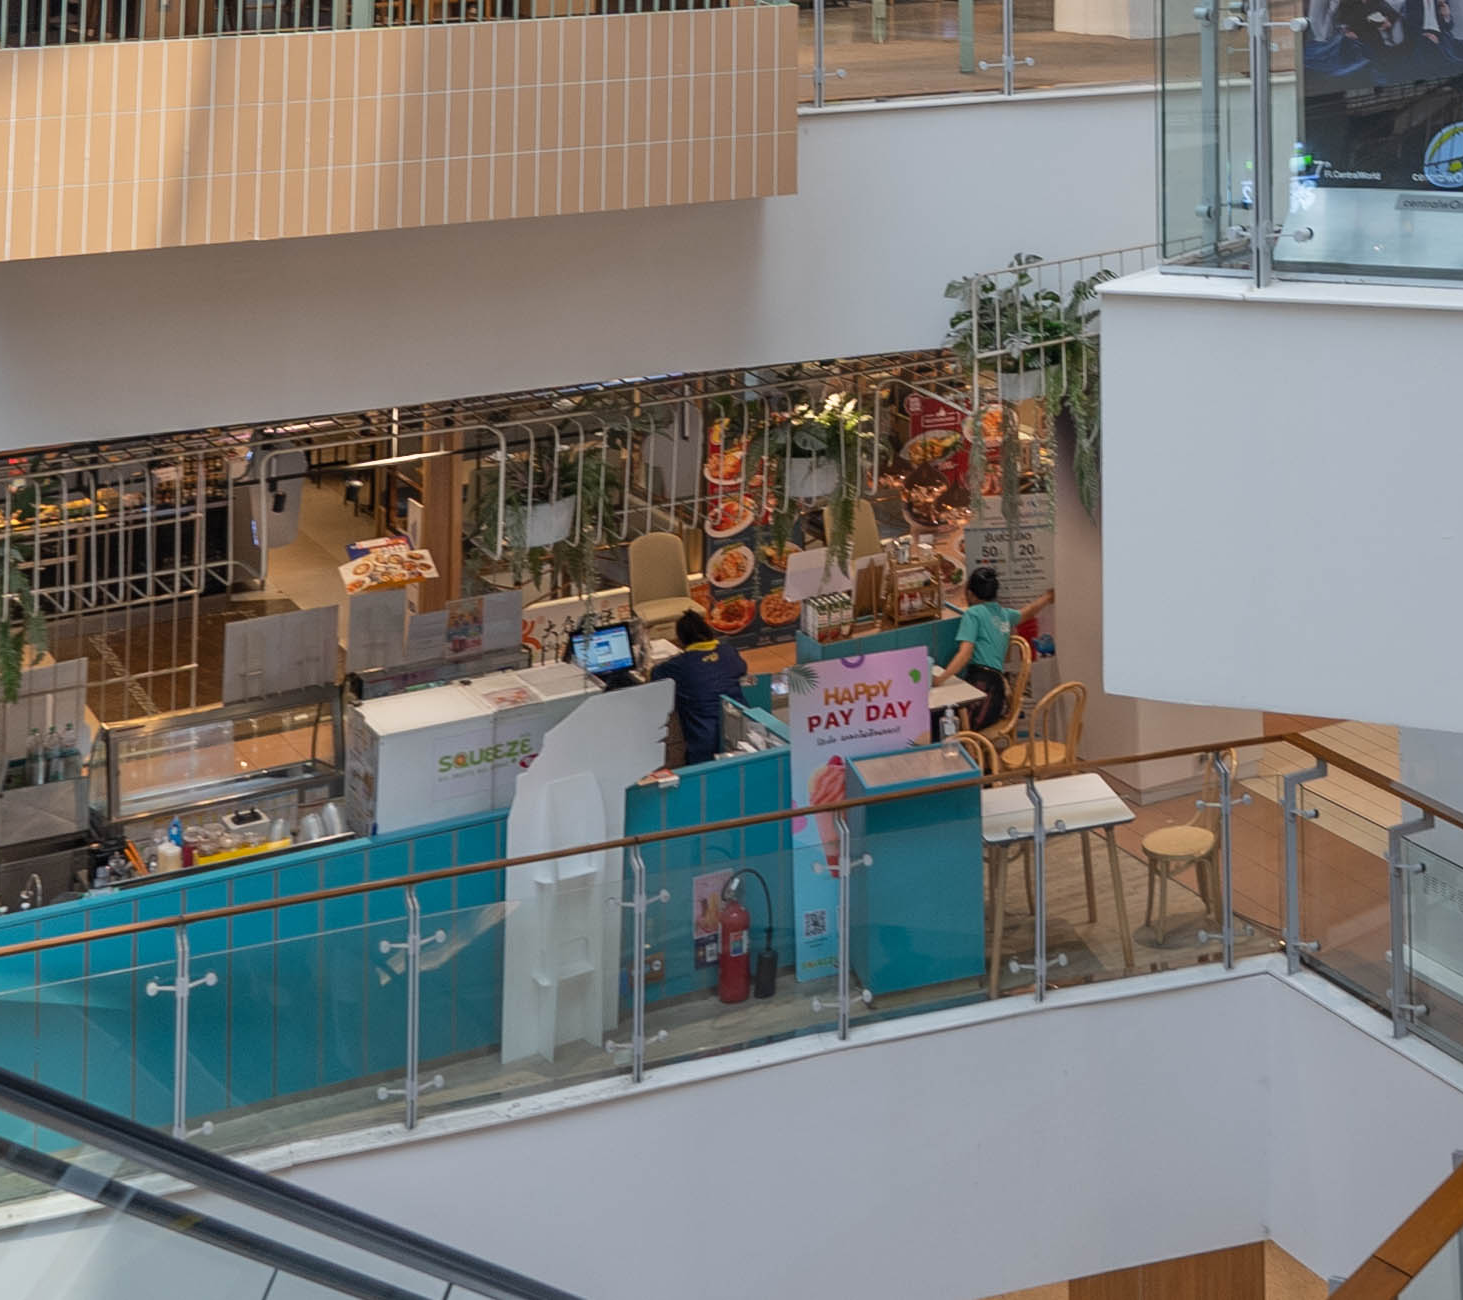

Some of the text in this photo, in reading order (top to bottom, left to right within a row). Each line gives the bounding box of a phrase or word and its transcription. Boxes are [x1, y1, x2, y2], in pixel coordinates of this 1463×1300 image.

[823, 679, 893, 706] HAPPY
[807, 700, 912, 733] PAY DAY
[438, 738, 534, 773] SQUEEZE
